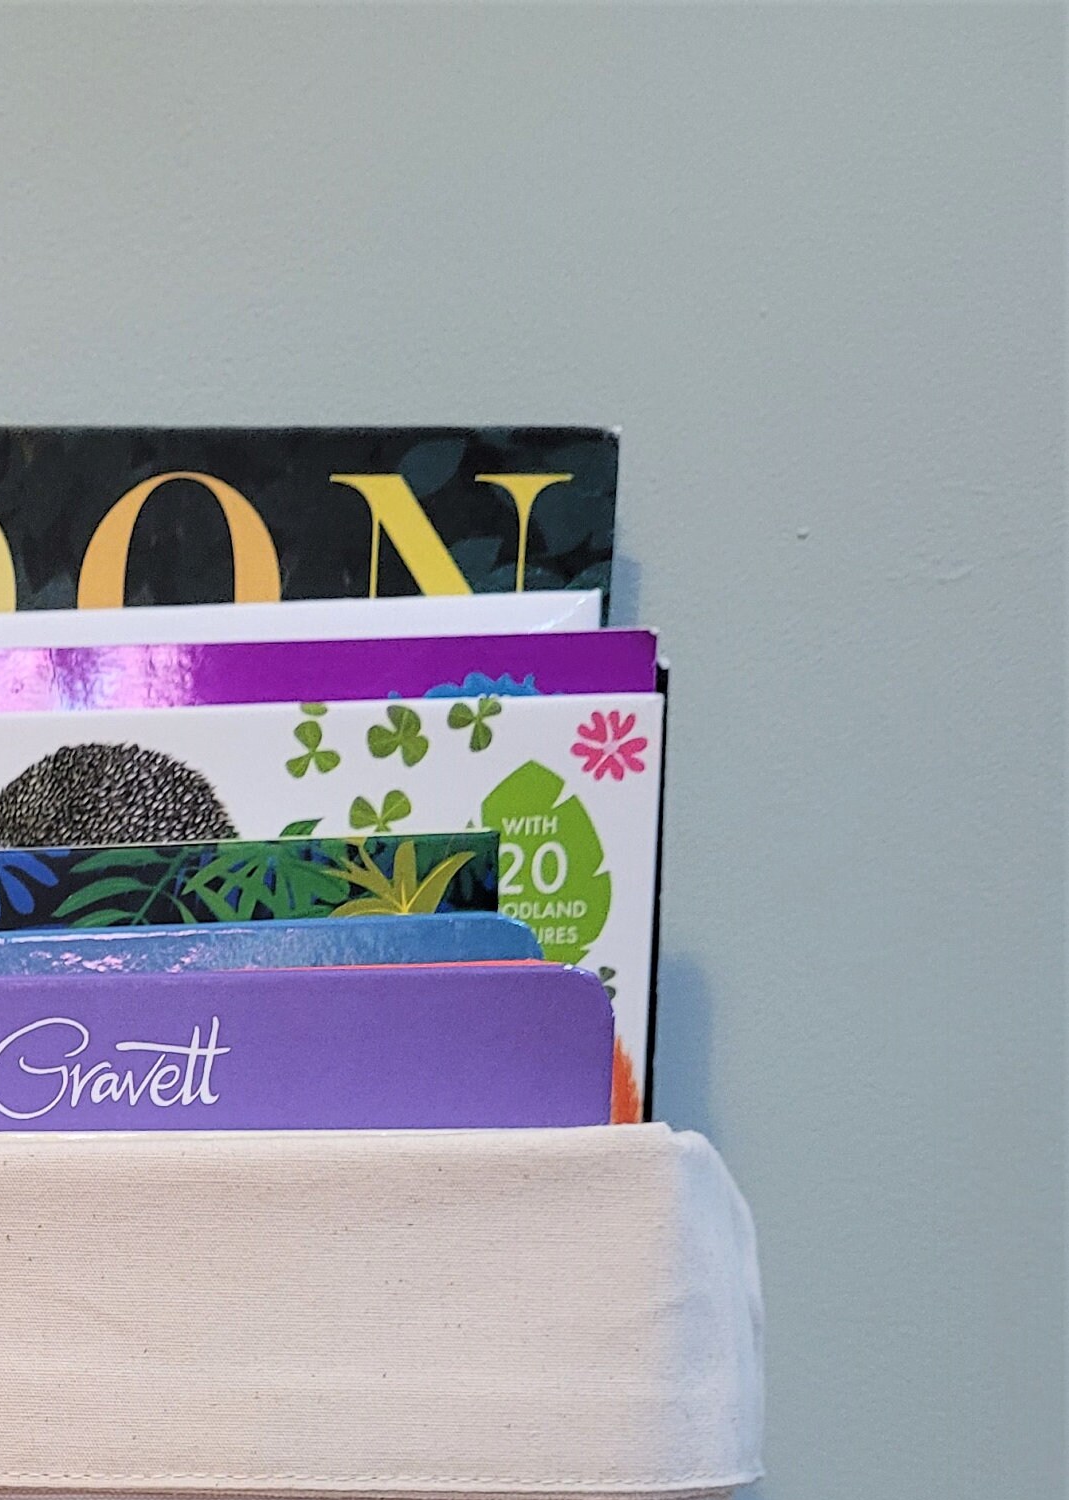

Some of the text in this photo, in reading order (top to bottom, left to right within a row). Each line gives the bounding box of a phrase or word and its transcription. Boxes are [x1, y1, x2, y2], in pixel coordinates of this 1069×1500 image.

[501, 815, 559, 837] WITH
[498, 841, 568, 895] 20
[502, 899, 589, 920] ODLAND
